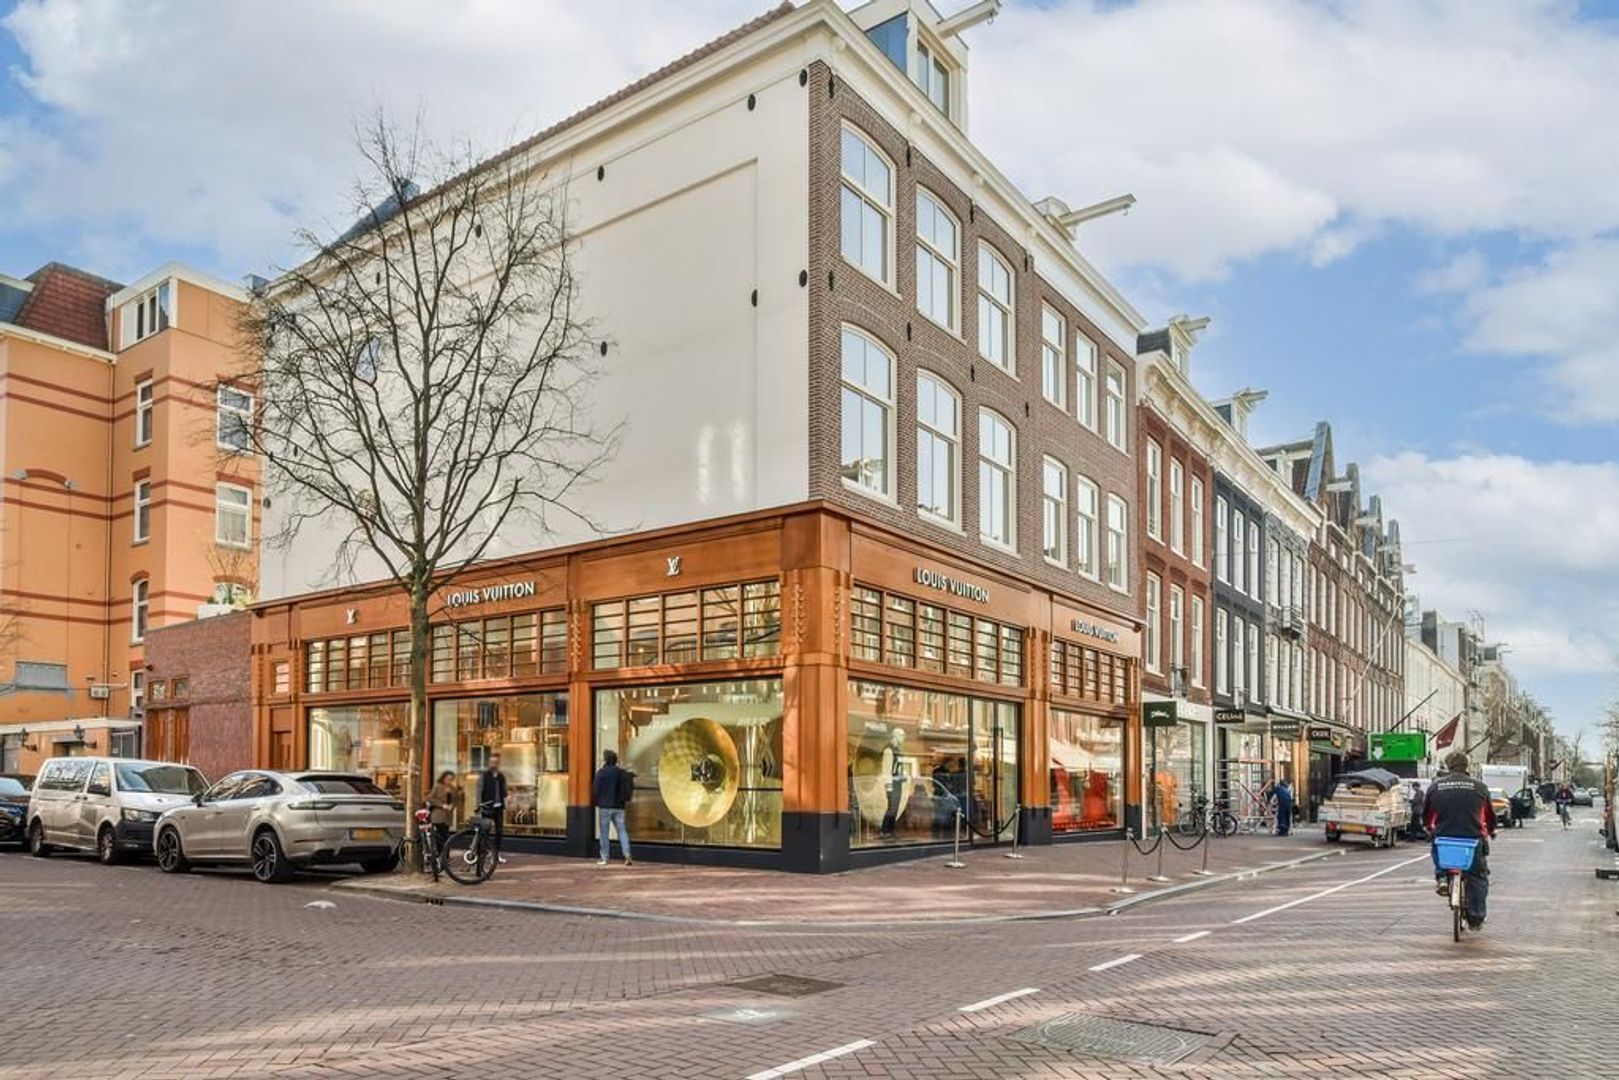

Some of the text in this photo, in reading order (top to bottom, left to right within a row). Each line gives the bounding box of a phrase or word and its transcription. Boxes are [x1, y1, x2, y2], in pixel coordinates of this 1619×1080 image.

[447, 581, 535, 607] LOUIS VUITTON
[915, 567, 990, 603] LOUIS VUITTON
